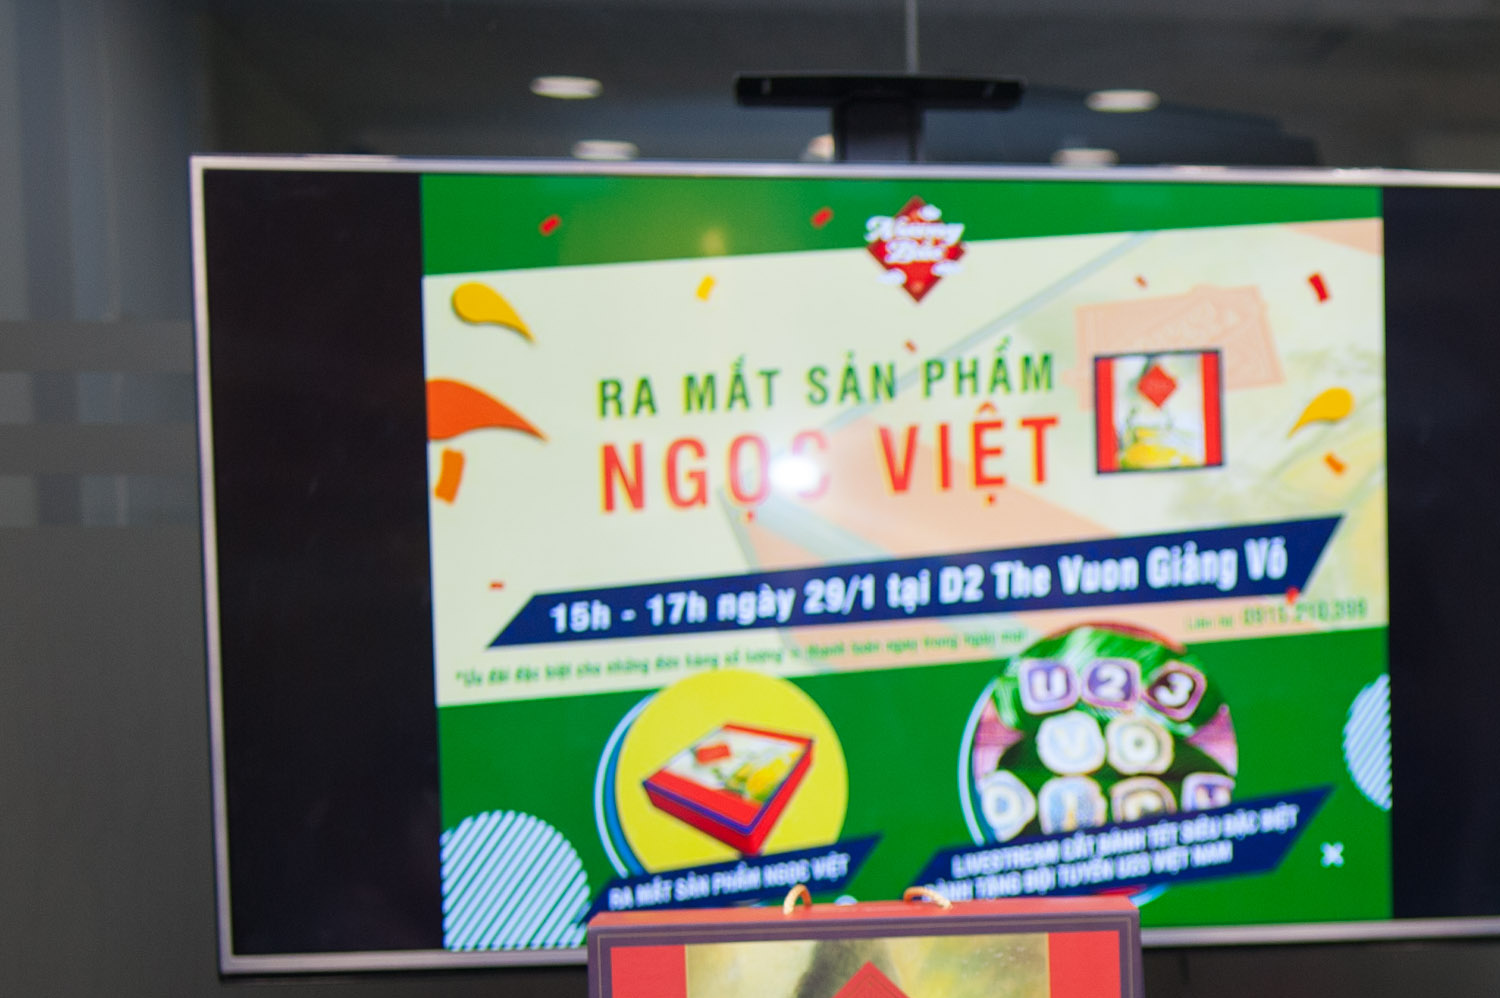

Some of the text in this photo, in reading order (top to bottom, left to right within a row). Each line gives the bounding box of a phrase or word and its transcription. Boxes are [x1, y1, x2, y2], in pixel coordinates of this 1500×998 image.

[599, 336, 1054, 418] RA MẮT SẢN PHẨM
[601, 402, 1059, 523] NGỌC VIỆT
[549, 600, 611, 633] 15h
[651, 592, 706, 625] 17h
[717, 587, 795, 627] ngày
[804, 574, 875, 616] 29/1
[886, 569, 930, 614] tại
[939, 568, 983, 603] D2
[992, 561, 1051, 599] The
[1146, 540, 1238, 592] Giảng
[1244, 535, 1287, 580] Võ
[608, 887, 635, 911] RA
